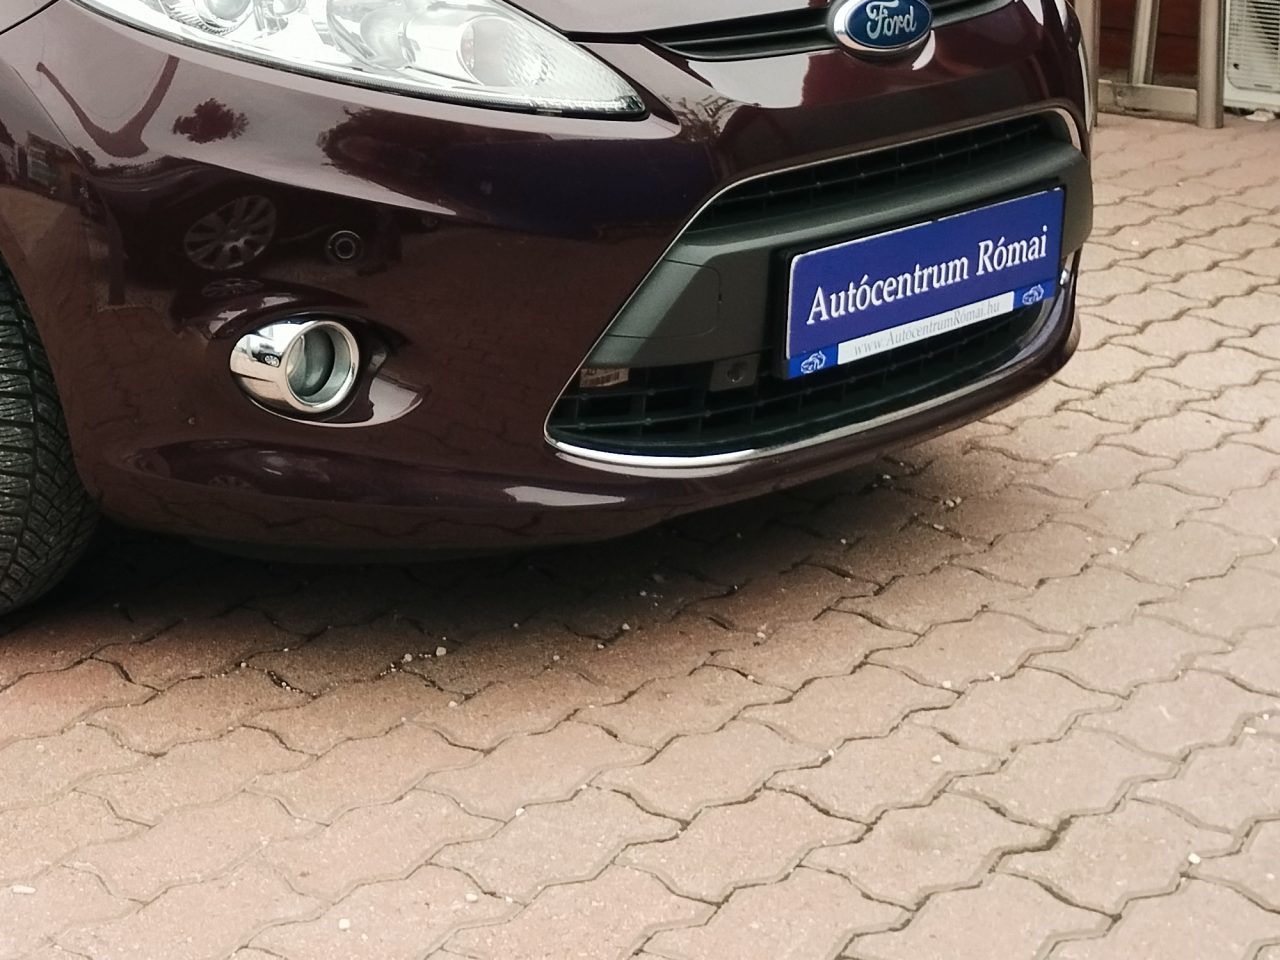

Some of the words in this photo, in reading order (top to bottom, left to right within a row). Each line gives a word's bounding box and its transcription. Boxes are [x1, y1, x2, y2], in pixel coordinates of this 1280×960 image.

[865, 0, 918, 39] Ford
[806, 256, 969, 325] Autócentrum
[976, 224, 1048, 277] Római
